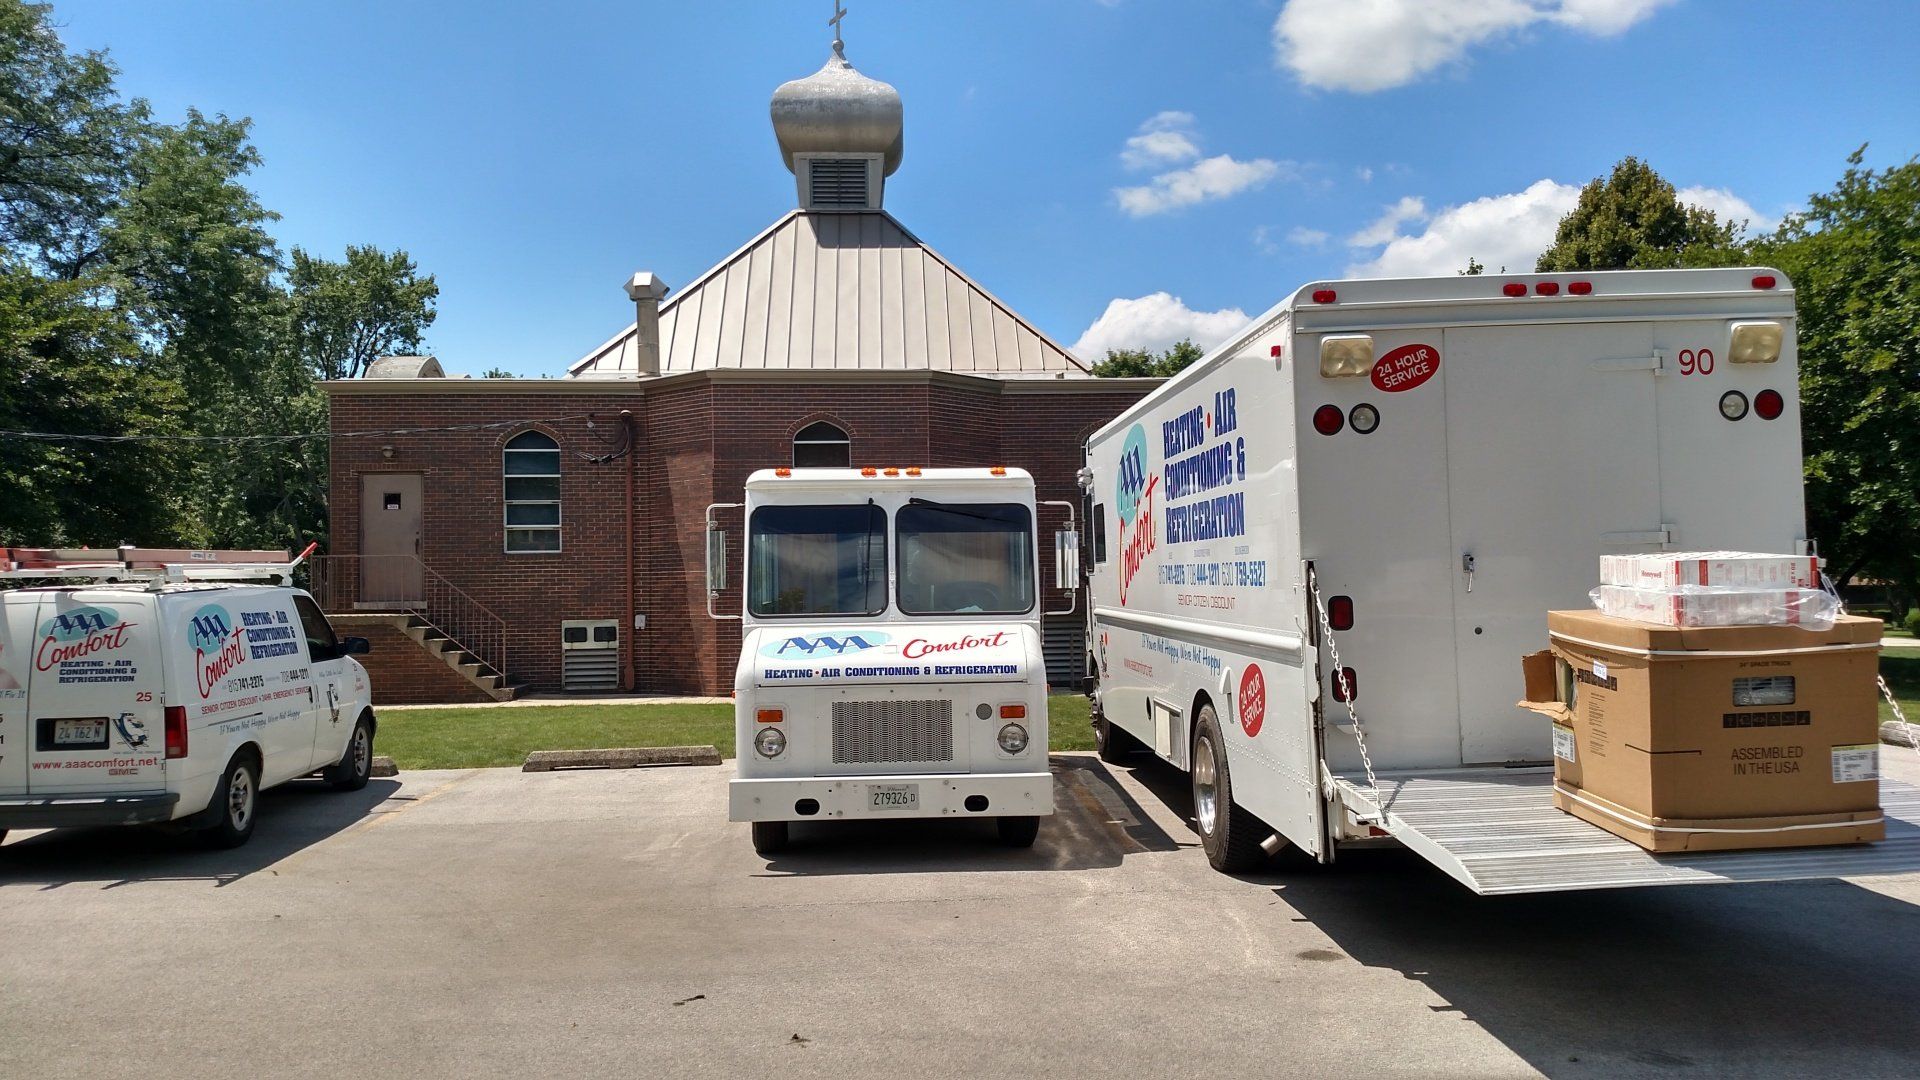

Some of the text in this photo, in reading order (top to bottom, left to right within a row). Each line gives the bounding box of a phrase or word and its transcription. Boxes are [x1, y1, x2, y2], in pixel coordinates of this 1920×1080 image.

[1377, 349, 1429, 378] 24 HOUR
[1678, 348, 1715, 376] 90
[1383, 362, 1430, 388] SERVICE
[1162, 387, 1237, 460] HEATING AIR
[1119, 444, 1146, 512] AAA
[1164, 436, 1246, 501] CONDITIONING &
[1165, 491, 1245, 544] REFRIGERATION
[1119, 472, 1159, 606] Comfort
[1196, 562, 1220, 586] 444-1211
[1221, 560, 1266, 587] 630 759-5527
[50, 613, 110, 635] AAA
[191, 614, 231, 646] AAA
[241, 610, 289, 626] HEATING AIR
[36, 621, 139, 672] Comfort
[246, 626, 290, 643] CONDITIONING
[777, 631, 1017, 660] AAA Comfort
[196, 626, 246, 699] Comfort
[250, 641, 299, 660] REFRIGERATION
[1202, 648, 1221, 677] Happy
[58, 667, 128, 676] CONDITIONING
[60, 659, 132, 668] HEATING AIR
[289, 668, 309, 681] 444-1211
[764, 664, 1018, 680] HEATING AIR CONDITIONING & REFRIGERATION
[58, 675, 135, 684] REFRIGERATION
[239, 675, 265, 691] 741-2275
[1246, 673, 1261, 702] HOUR
[136, 691, 152, 702] 25
[201, 704, 219, 715] SENIOR
[220, 700, 237, 711] CITIZEN
[238, 696, 258, 707] DISCOUNT
[273, 688, 295, 700] EMERGENCY
[294, 685, 310, 695] SERVICE
[1243, 694, 1263, 729] SERVICE
[32, 756, 158, 770] www.aaacomfort.net
[1731, 745, 1804, 761] ASSEMBLED
[108, 768, 139, 776] GMC
[1733, 760, 1801, 775] IN THE USA
[873, 791, 916, 806] 279326 D
